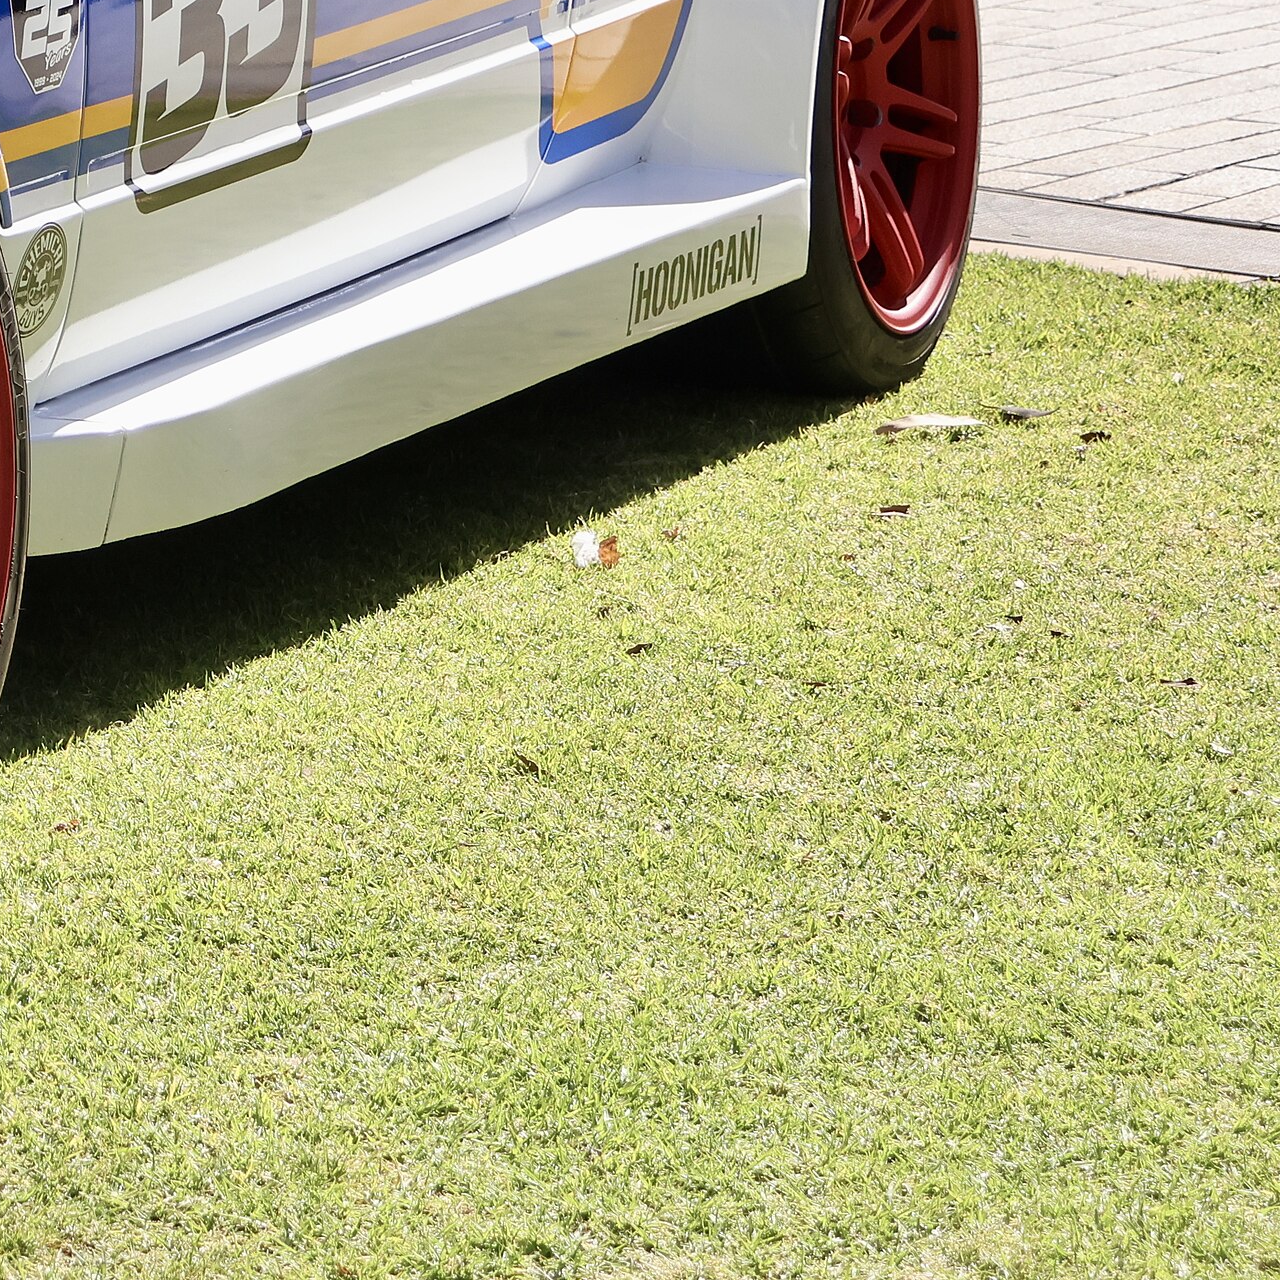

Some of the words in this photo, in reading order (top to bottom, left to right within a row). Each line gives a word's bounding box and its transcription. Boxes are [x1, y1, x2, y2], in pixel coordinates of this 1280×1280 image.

[45, 43, 72, 70] Years
[20, 232, 63, 288] CHEMICAL
[20, 306, 45, 329] GUYS
